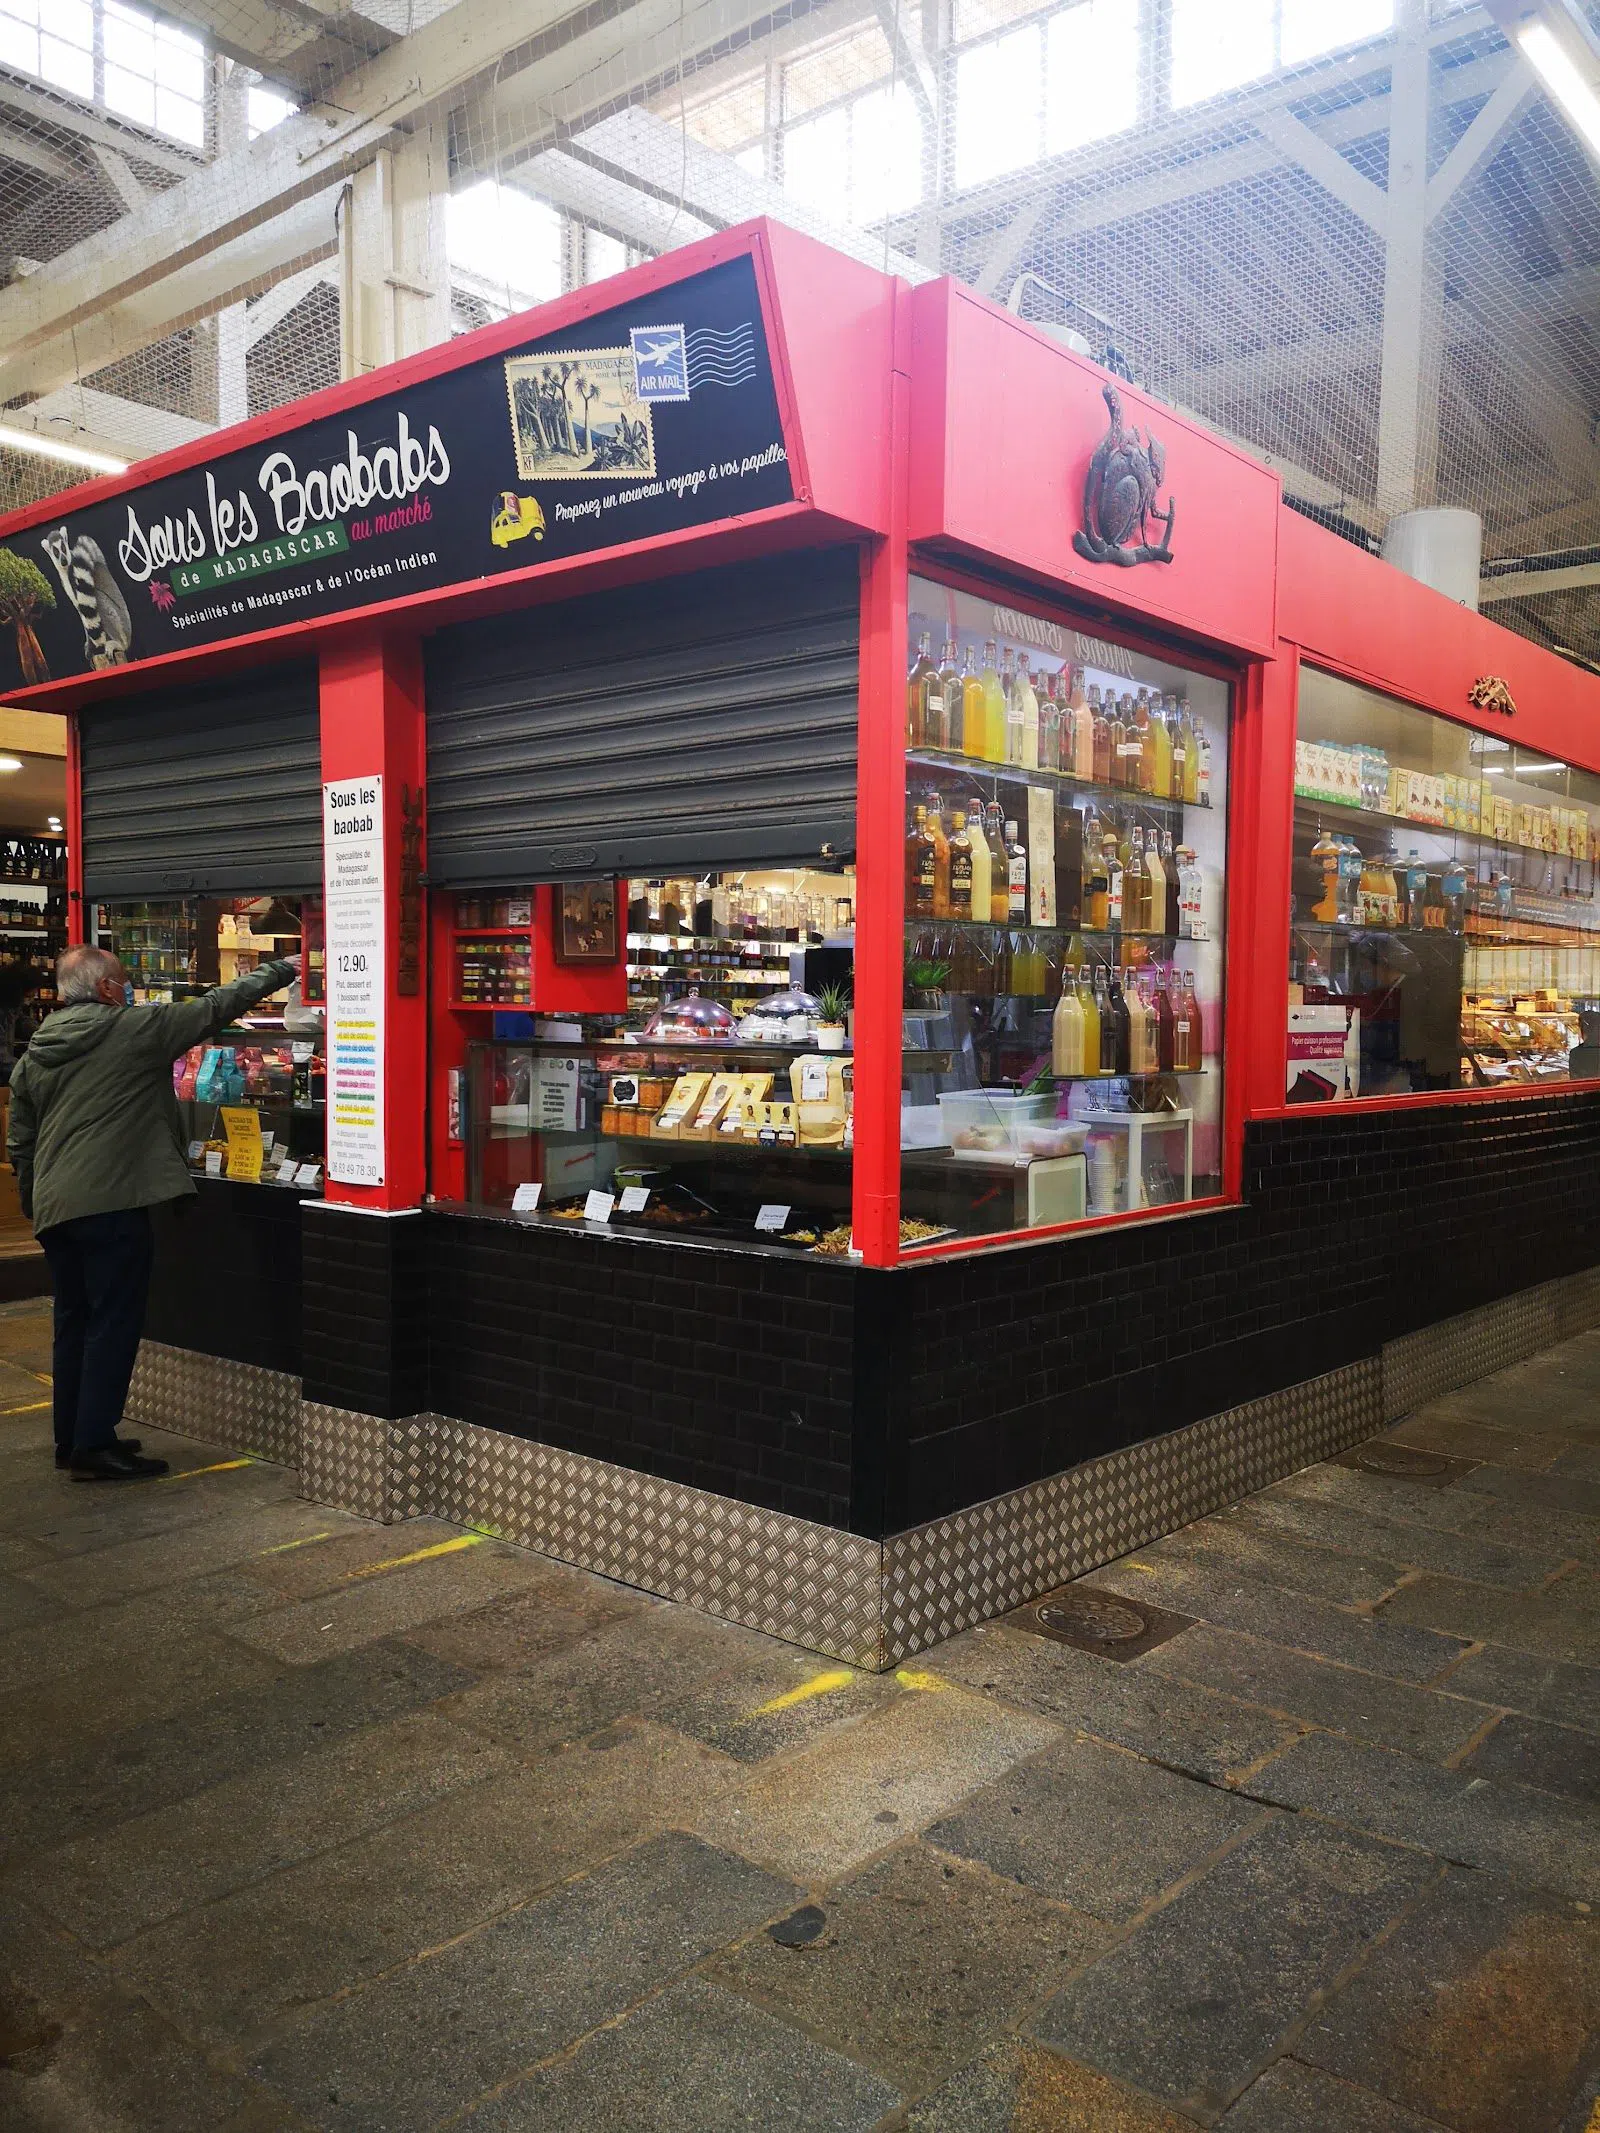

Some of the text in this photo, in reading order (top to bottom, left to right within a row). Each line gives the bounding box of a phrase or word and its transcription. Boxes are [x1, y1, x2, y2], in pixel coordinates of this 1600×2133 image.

[640, 375, 682, 390] AIR MAIL
[118, 411, 451, 582] Sous les Baobabs
[555, 497, 601, 523] Proposez
[602, 493, 618, 509] un
[618, 481, 665, 504] nouveau
[666, 469, 707, 498] voyage
[708, 463, 718, 480] à
[719, 459, 740, 477] vos
[351, 493, 433, 541] au marché
[180, 530, 339, 588] de MADAGASCAR
[171, 604, 229, 630] Spécialités
[231, 600, 245, 614] de
[246, 583, 313, 610] Madagascar
[316, 578, 325, 593] &
[328, 574, 343, 590] de
[395, 550, 438, 573] Indien
[330, 787, 376, 809] Sous les
[333, 815, 373, 836] baobab
[337, 863, 369, 875] Madagascar
[356, 1165, 365, 1176] 78
[366, 1166, 376, 1177] 30
